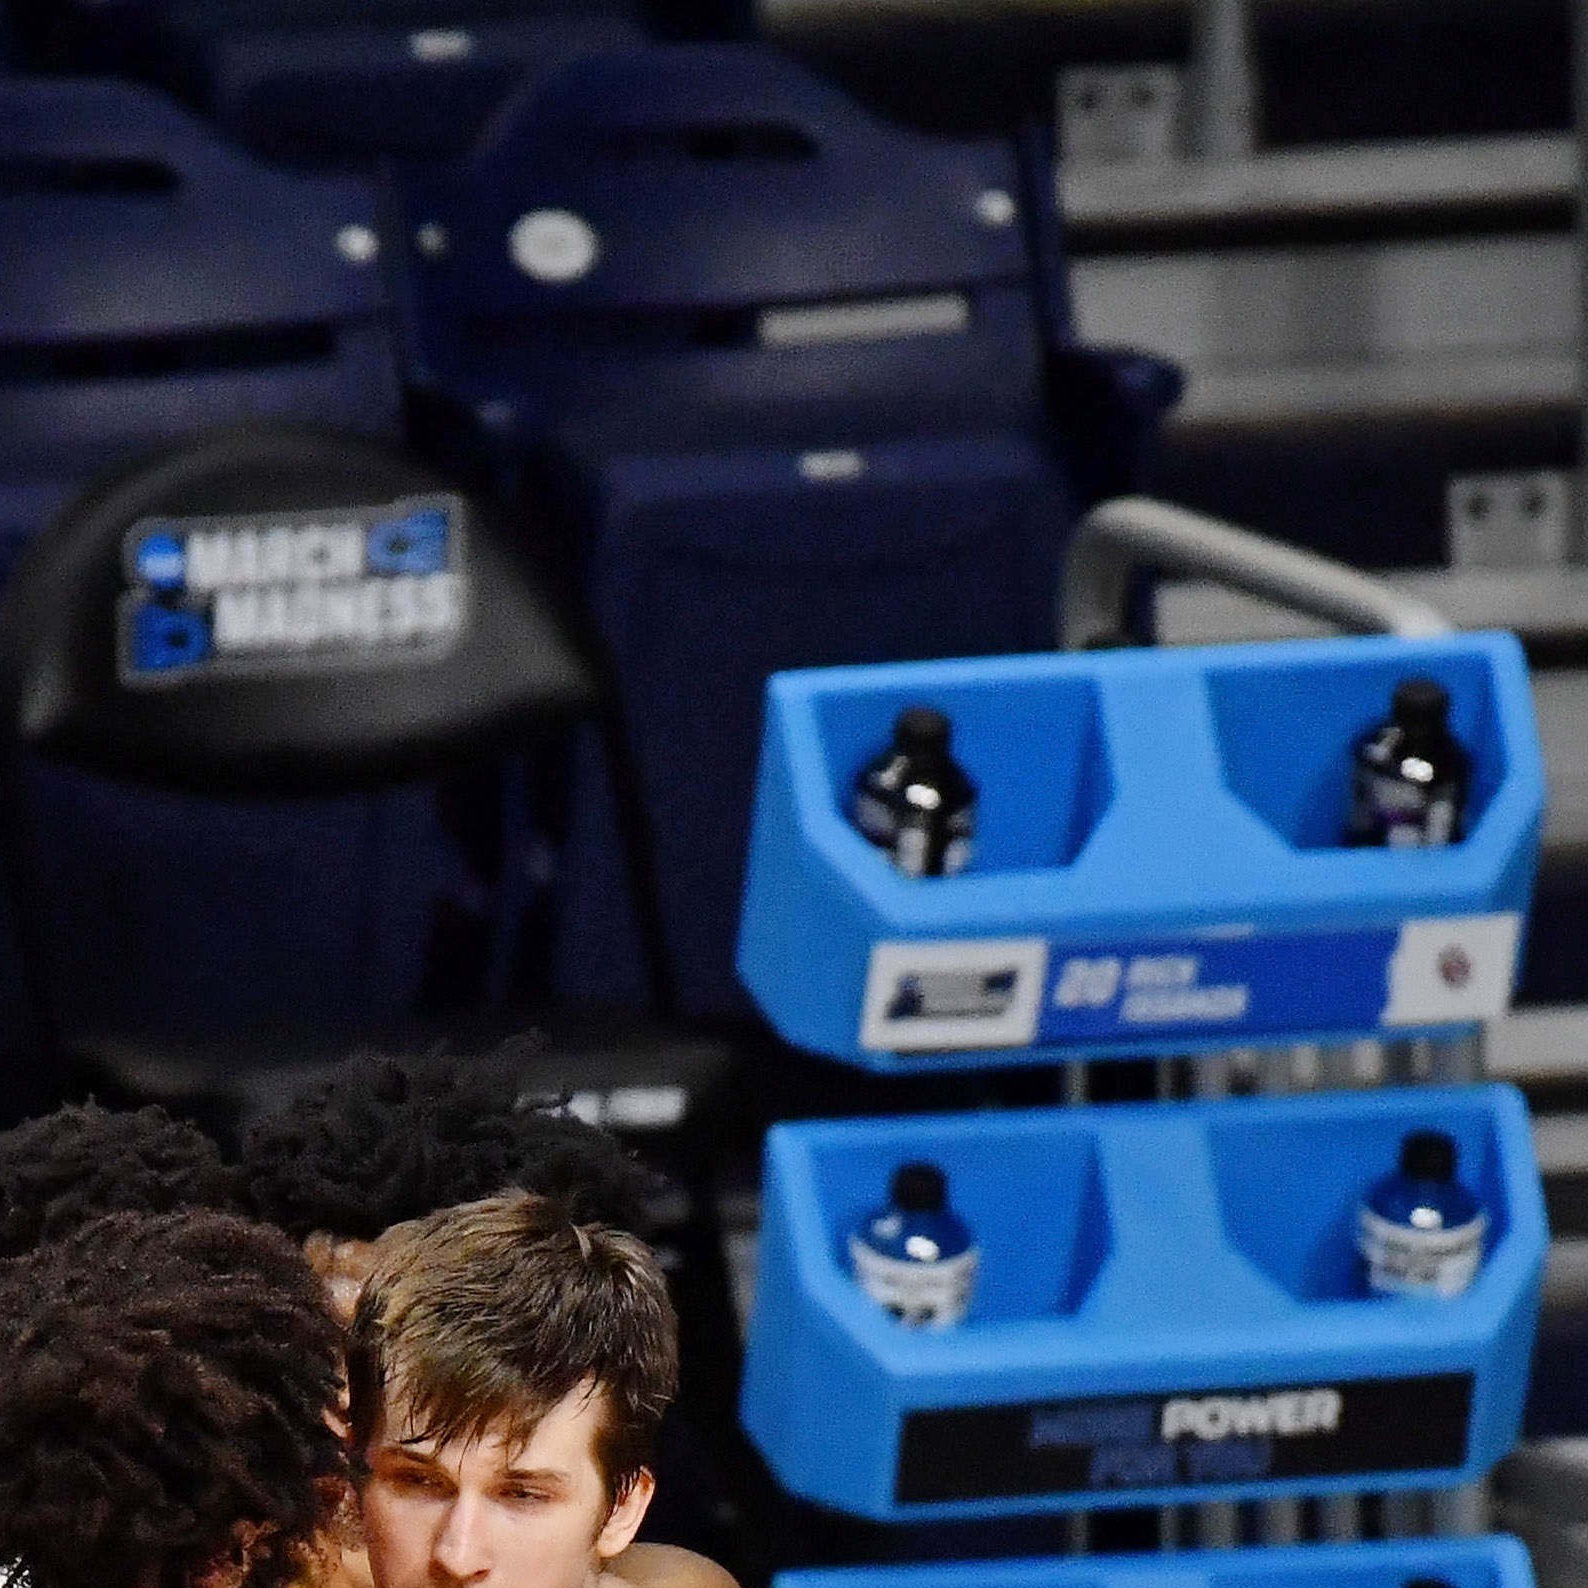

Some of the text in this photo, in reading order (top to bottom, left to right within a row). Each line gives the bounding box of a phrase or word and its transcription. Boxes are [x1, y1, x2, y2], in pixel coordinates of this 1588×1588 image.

[186, 527, 363, 592] MARCH
[215, 573, 454, 650] MADNESS
[1162, 1388, 1343, 1441] POWER
